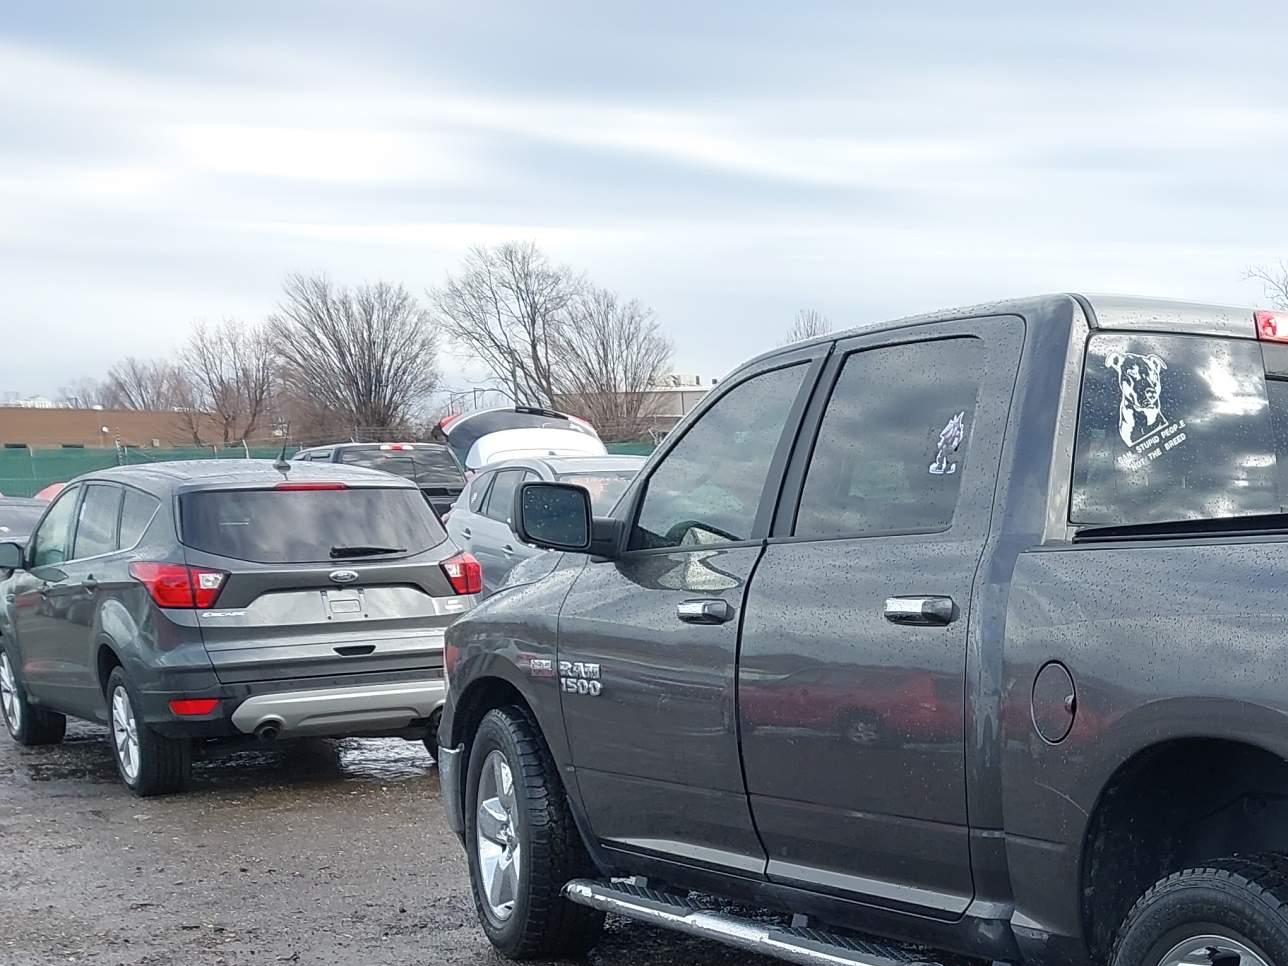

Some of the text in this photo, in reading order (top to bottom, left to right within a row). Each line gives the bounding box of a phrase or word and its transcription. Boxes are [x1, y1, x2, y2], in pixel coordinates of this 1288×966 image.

[1135, 435, 1160, 453] STUPID
[1147, 448, 1162, 460] THE
[1164, 432, 1187, 451] BREED
[559, 660, 601, 679] RAM
[560, 677, 602, 696] 1500
